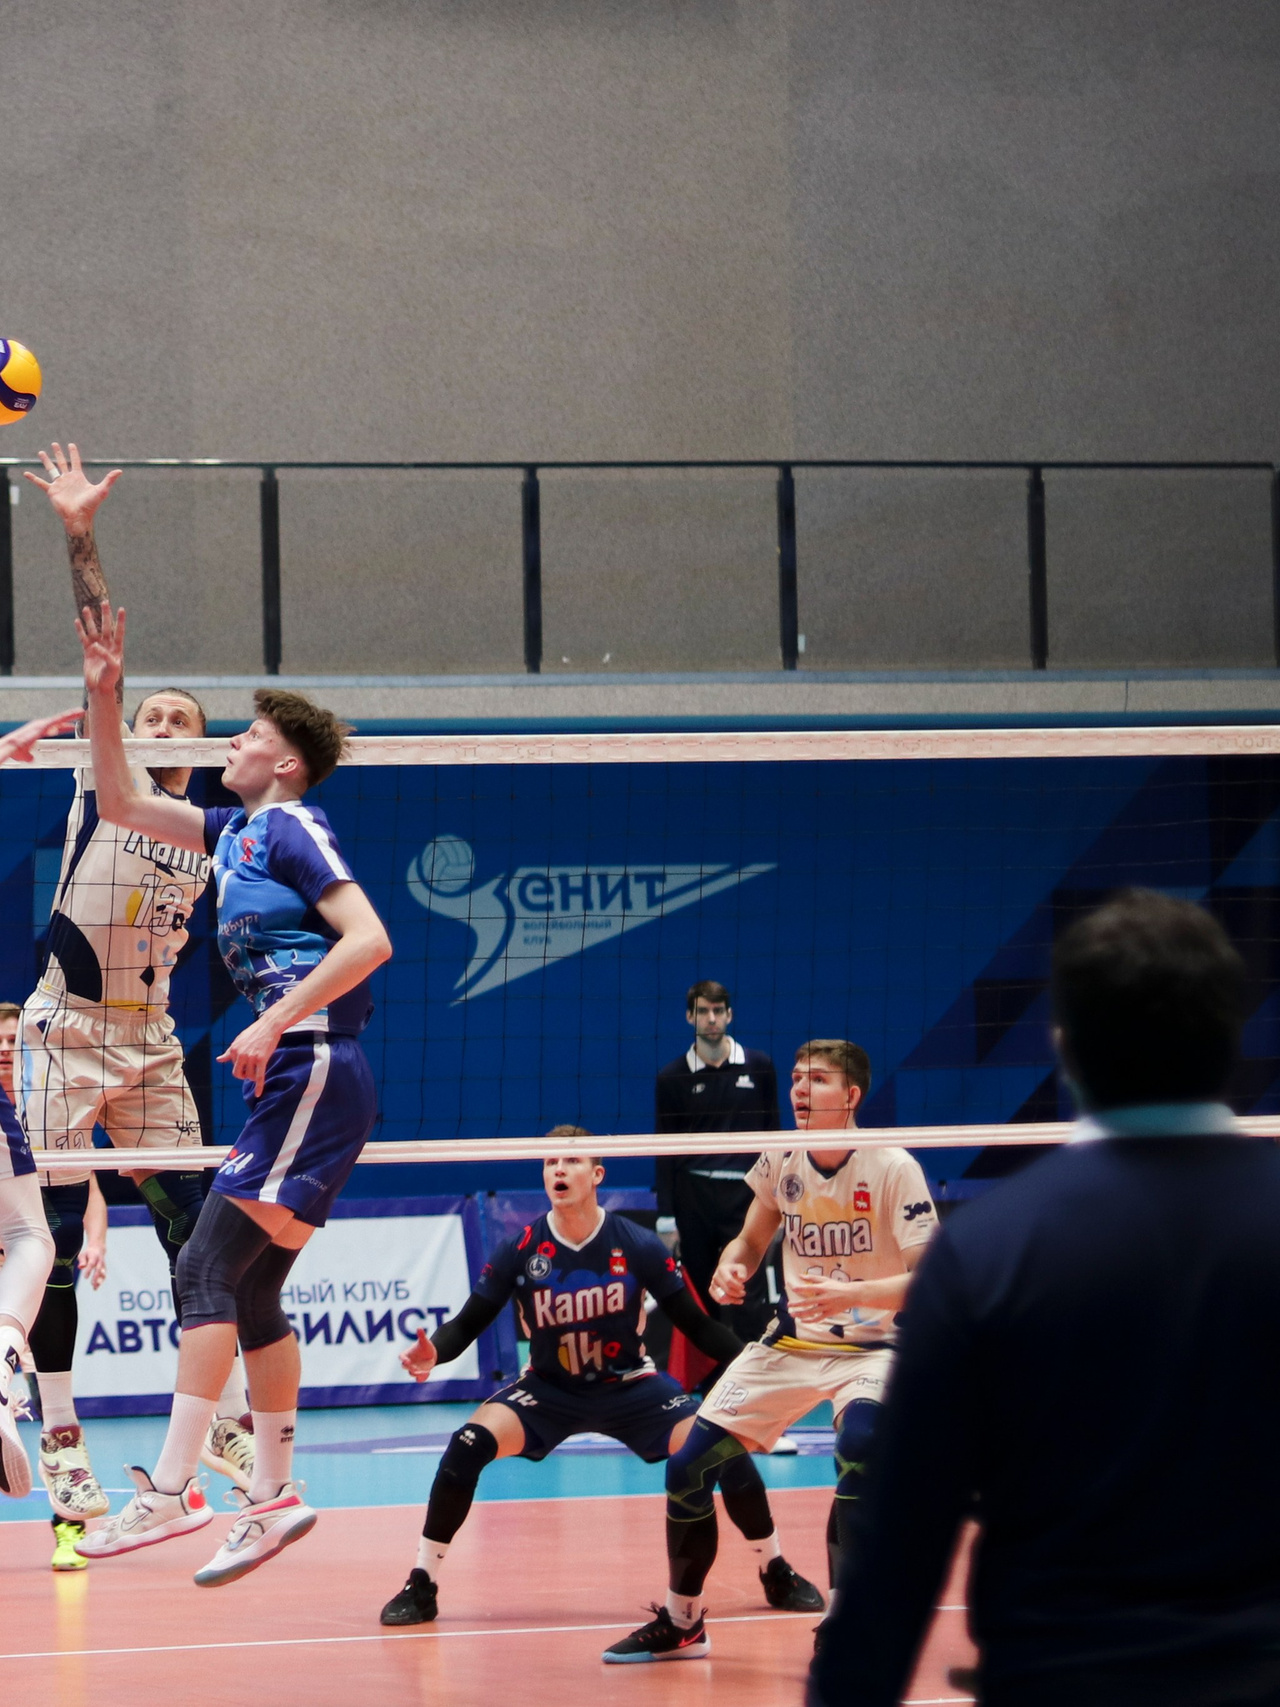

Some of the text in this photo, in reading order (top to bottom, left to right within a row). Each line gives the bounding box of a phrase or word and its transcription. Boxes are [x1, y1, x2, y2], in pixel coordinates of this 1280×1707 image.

[783, 1214, 873, 1258] Kama
[344, 1280, 410, 1303] КЛУБ
[532, 1281, 627, 1328] Kama
[558, 1331, 603, 1376] 14
[713, 1379, 750, 1416] 12
